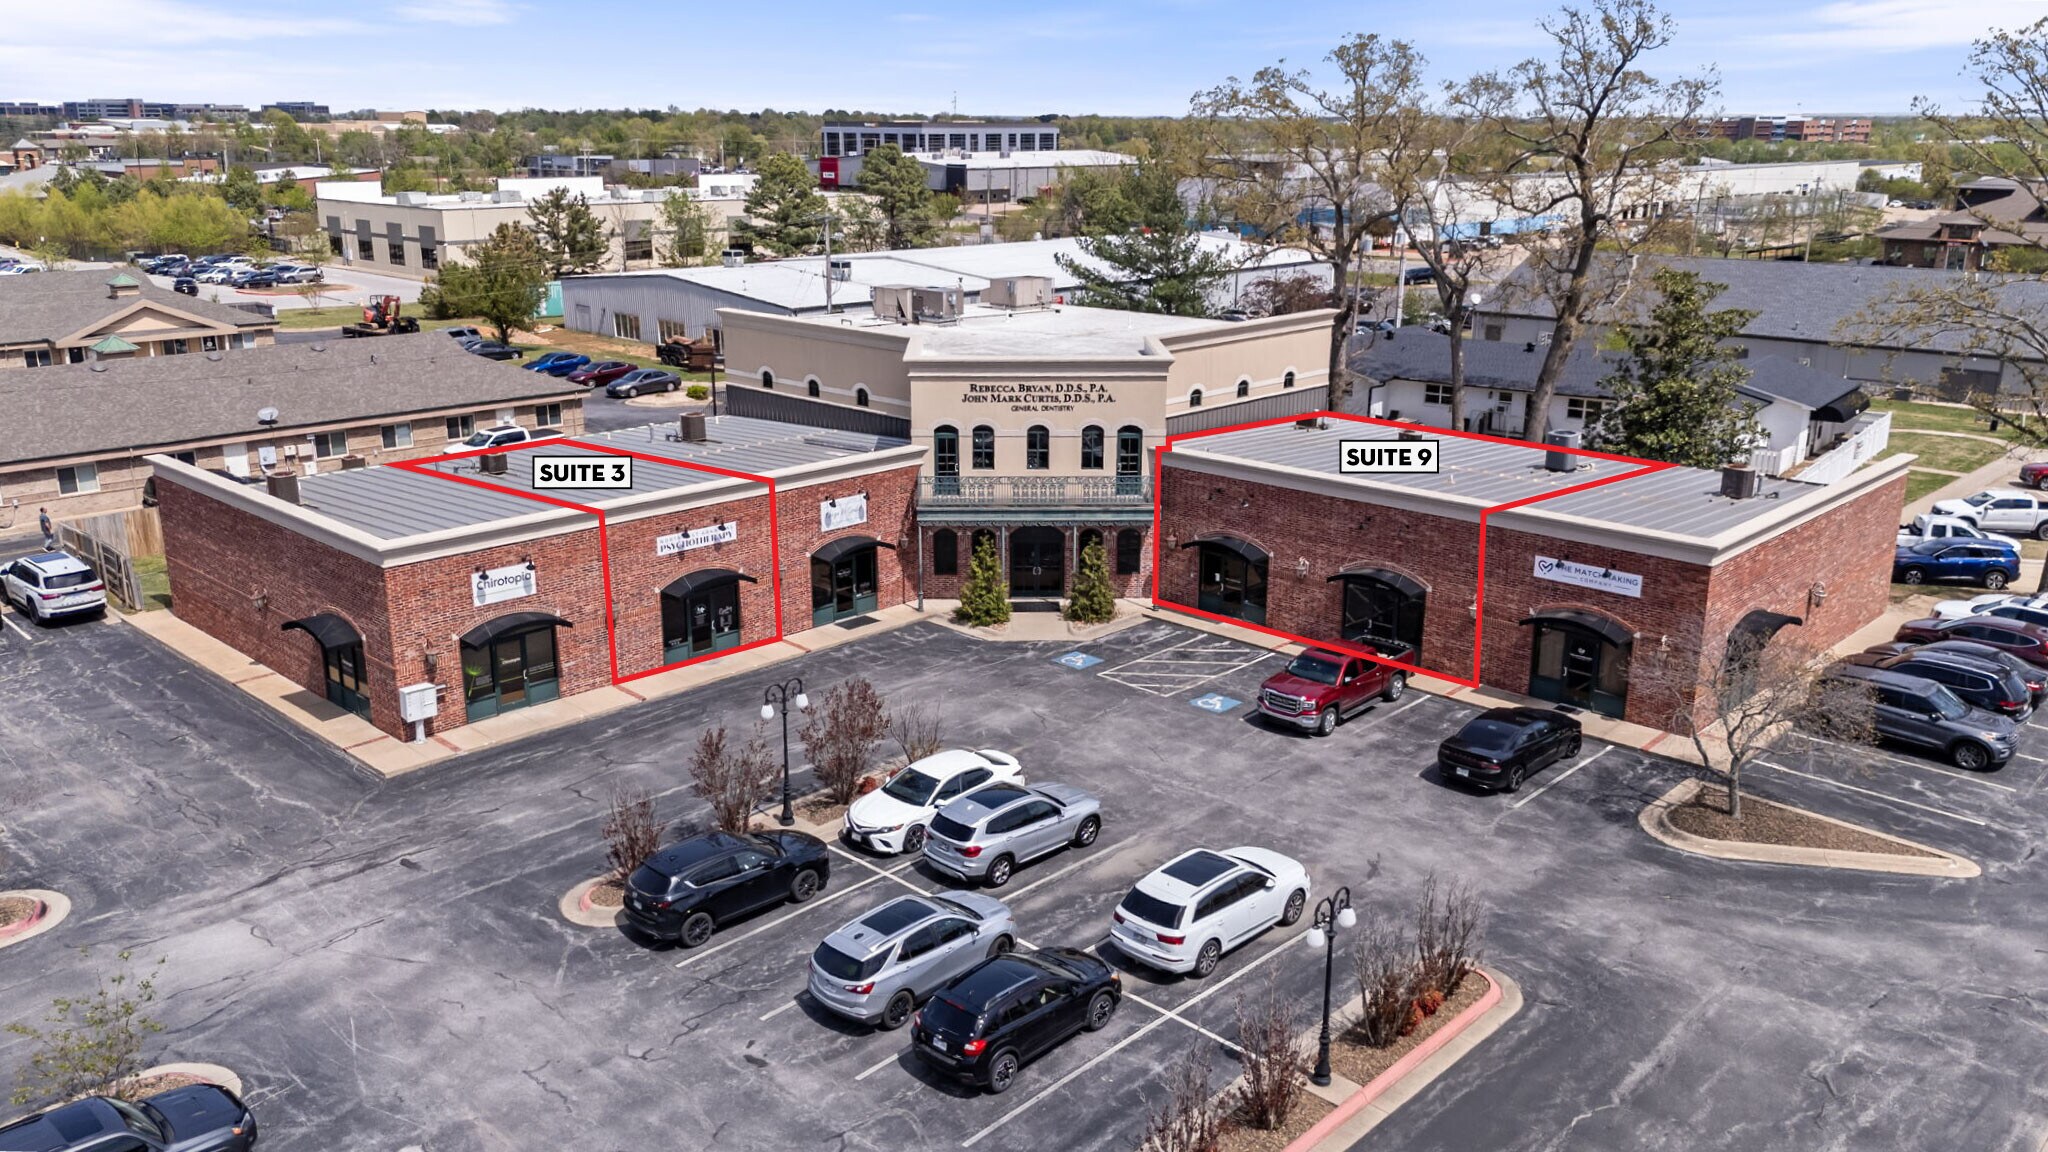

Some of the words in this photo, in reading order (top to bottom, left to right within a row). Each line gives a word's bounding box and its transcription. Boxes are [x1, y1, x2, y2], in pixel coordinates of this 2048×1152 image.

[970, 384, 1015, 393] REBECCA
[1018, 384, 1054, 394] BRYAN,
[1090, 384, 1108, 393] P.A.
[962, 394, 988, 403] JOHN
[990, 394, 1022, 403] MARK
[1023, 394, 1062, 404] CURTIS,
[1098, 394, 1116, 403] P.A.
